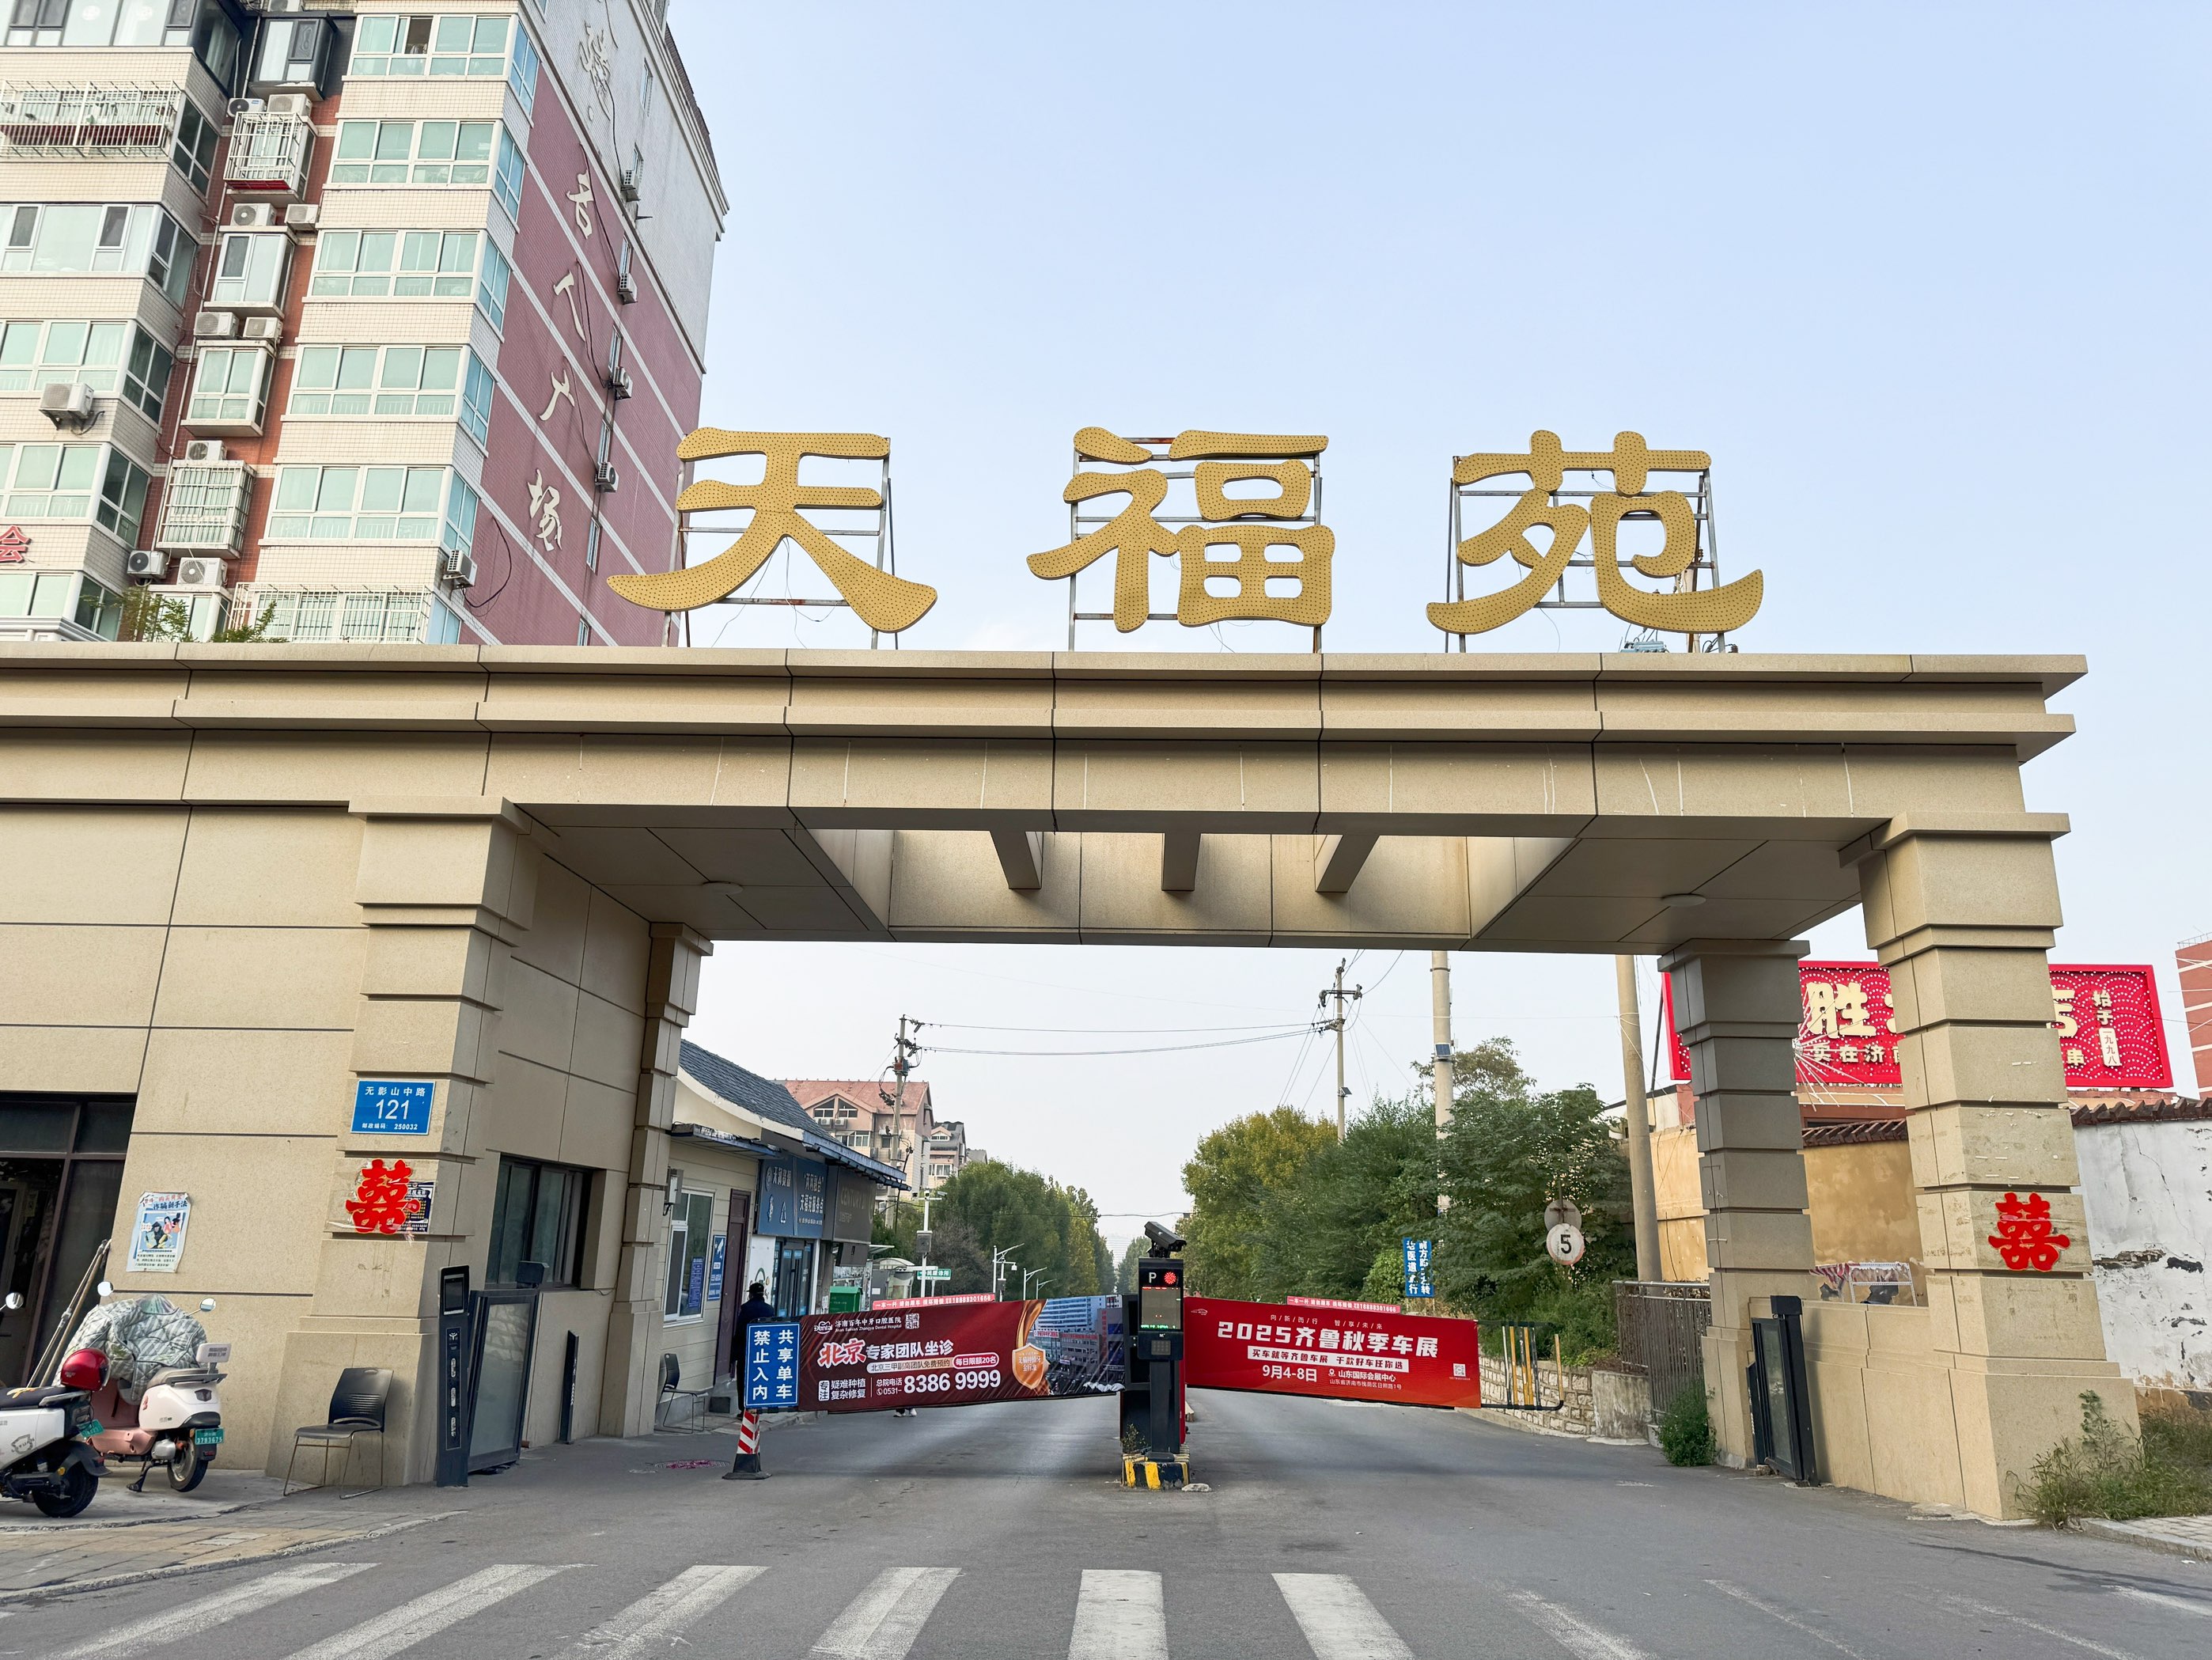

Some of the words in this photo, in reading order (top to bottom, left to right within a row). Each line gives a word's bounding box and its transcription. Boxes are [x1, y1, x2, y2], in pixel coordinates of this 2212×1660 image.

[527, 170, 594, 552] 名人广场
[607, 426, 1764, 634] 天福苑
[1806, 982, 1896, 1039] 胜
[2093, 990, 2113, 1025] 始于
[2102, 1030, 2118, 1064] 一九九八
[2066, 1048, 2085, 1066] 串
[365, 1086, 426, 1097] 无影山中路
[376, 1099, 410, 1120] 121
[1561, 1234, 1572, 1253] 5
[1149, 1272, 1157, 1283] P
[835, 1317, 902, 1328] 济南百年中牙口腔医院
[1217, 1321, 1439, 1359] 2025齐鲁秋季车展
[817, 1338, 867, 1369] 北京
[865, 1340, 954, 1360] 专家团队坐诊
[956, 1355, 997, 1366] 每日限额20名
[1252, 1348, 1328, 1363] 买车就等齐鲁车展
[1336, 1356, 1403, 1370] 千款好车任你选
[753, 1330, 771, 1400] 禁止入内
[776, 1329, 794, 1400] 共享单车
[870, 1359, 950, 1372] 北京三甲副高团队免费预约
[1262, 1364, 1317, 1382] 9月4-8日
[831, 1378, 866, 1389] 疑难种植
[876, 1378, 903, 1387] 总院电话
[904, 1373, 950, 1393] 8386
[955, 1370, 1002, 1390] 9999
[1338, 1370, 1396, 1382] 山东国际会展中心
[820, 1381, 829, 1400] 专注
[831, 1389, 866, 1400] 复杂修复
